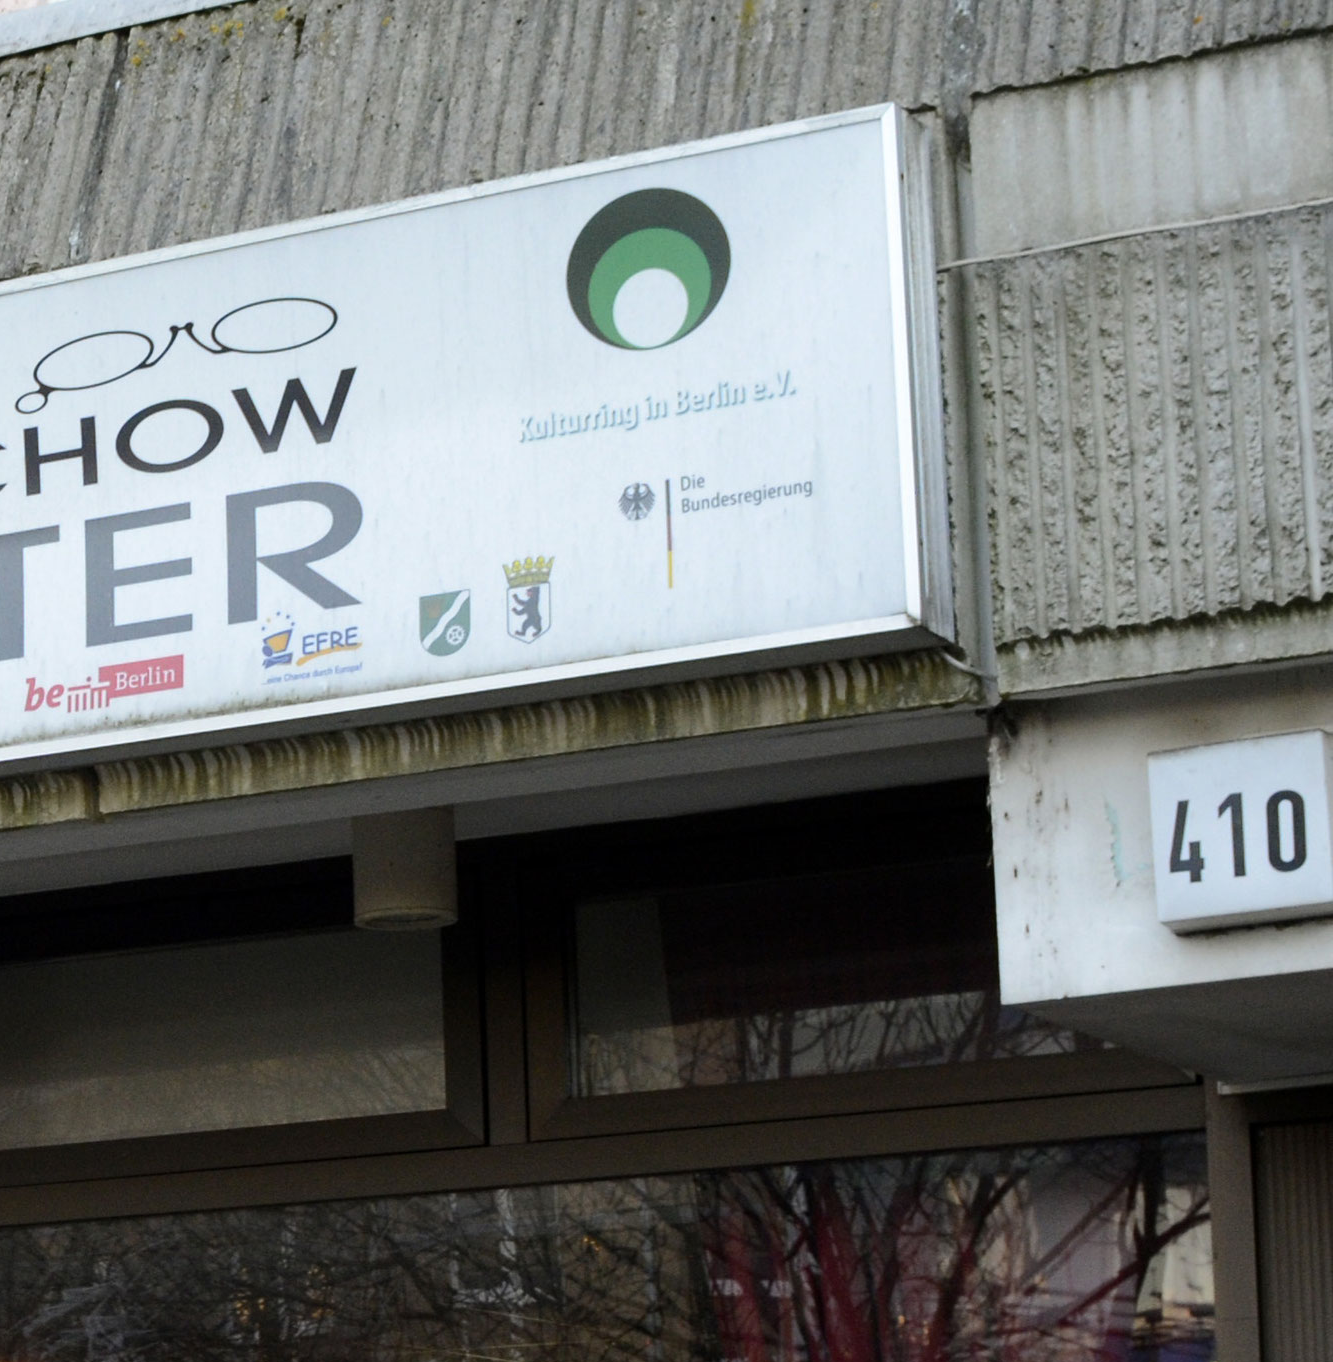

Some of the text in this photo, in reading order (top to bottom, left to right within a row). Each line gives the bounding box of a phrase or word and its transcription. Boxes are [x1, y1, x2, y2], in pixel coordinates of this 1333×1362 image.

[519, 370, 797, 443] Kulturring in Berlin e.V.
[680, 475, 706, 491] Die
[681, 479, 813, 514] Bundesregierung
[302, 626, 358, 655] EFRE
[24, 665, 175, 712] be Berlin
[1169, 789, 1308, 884] 410
